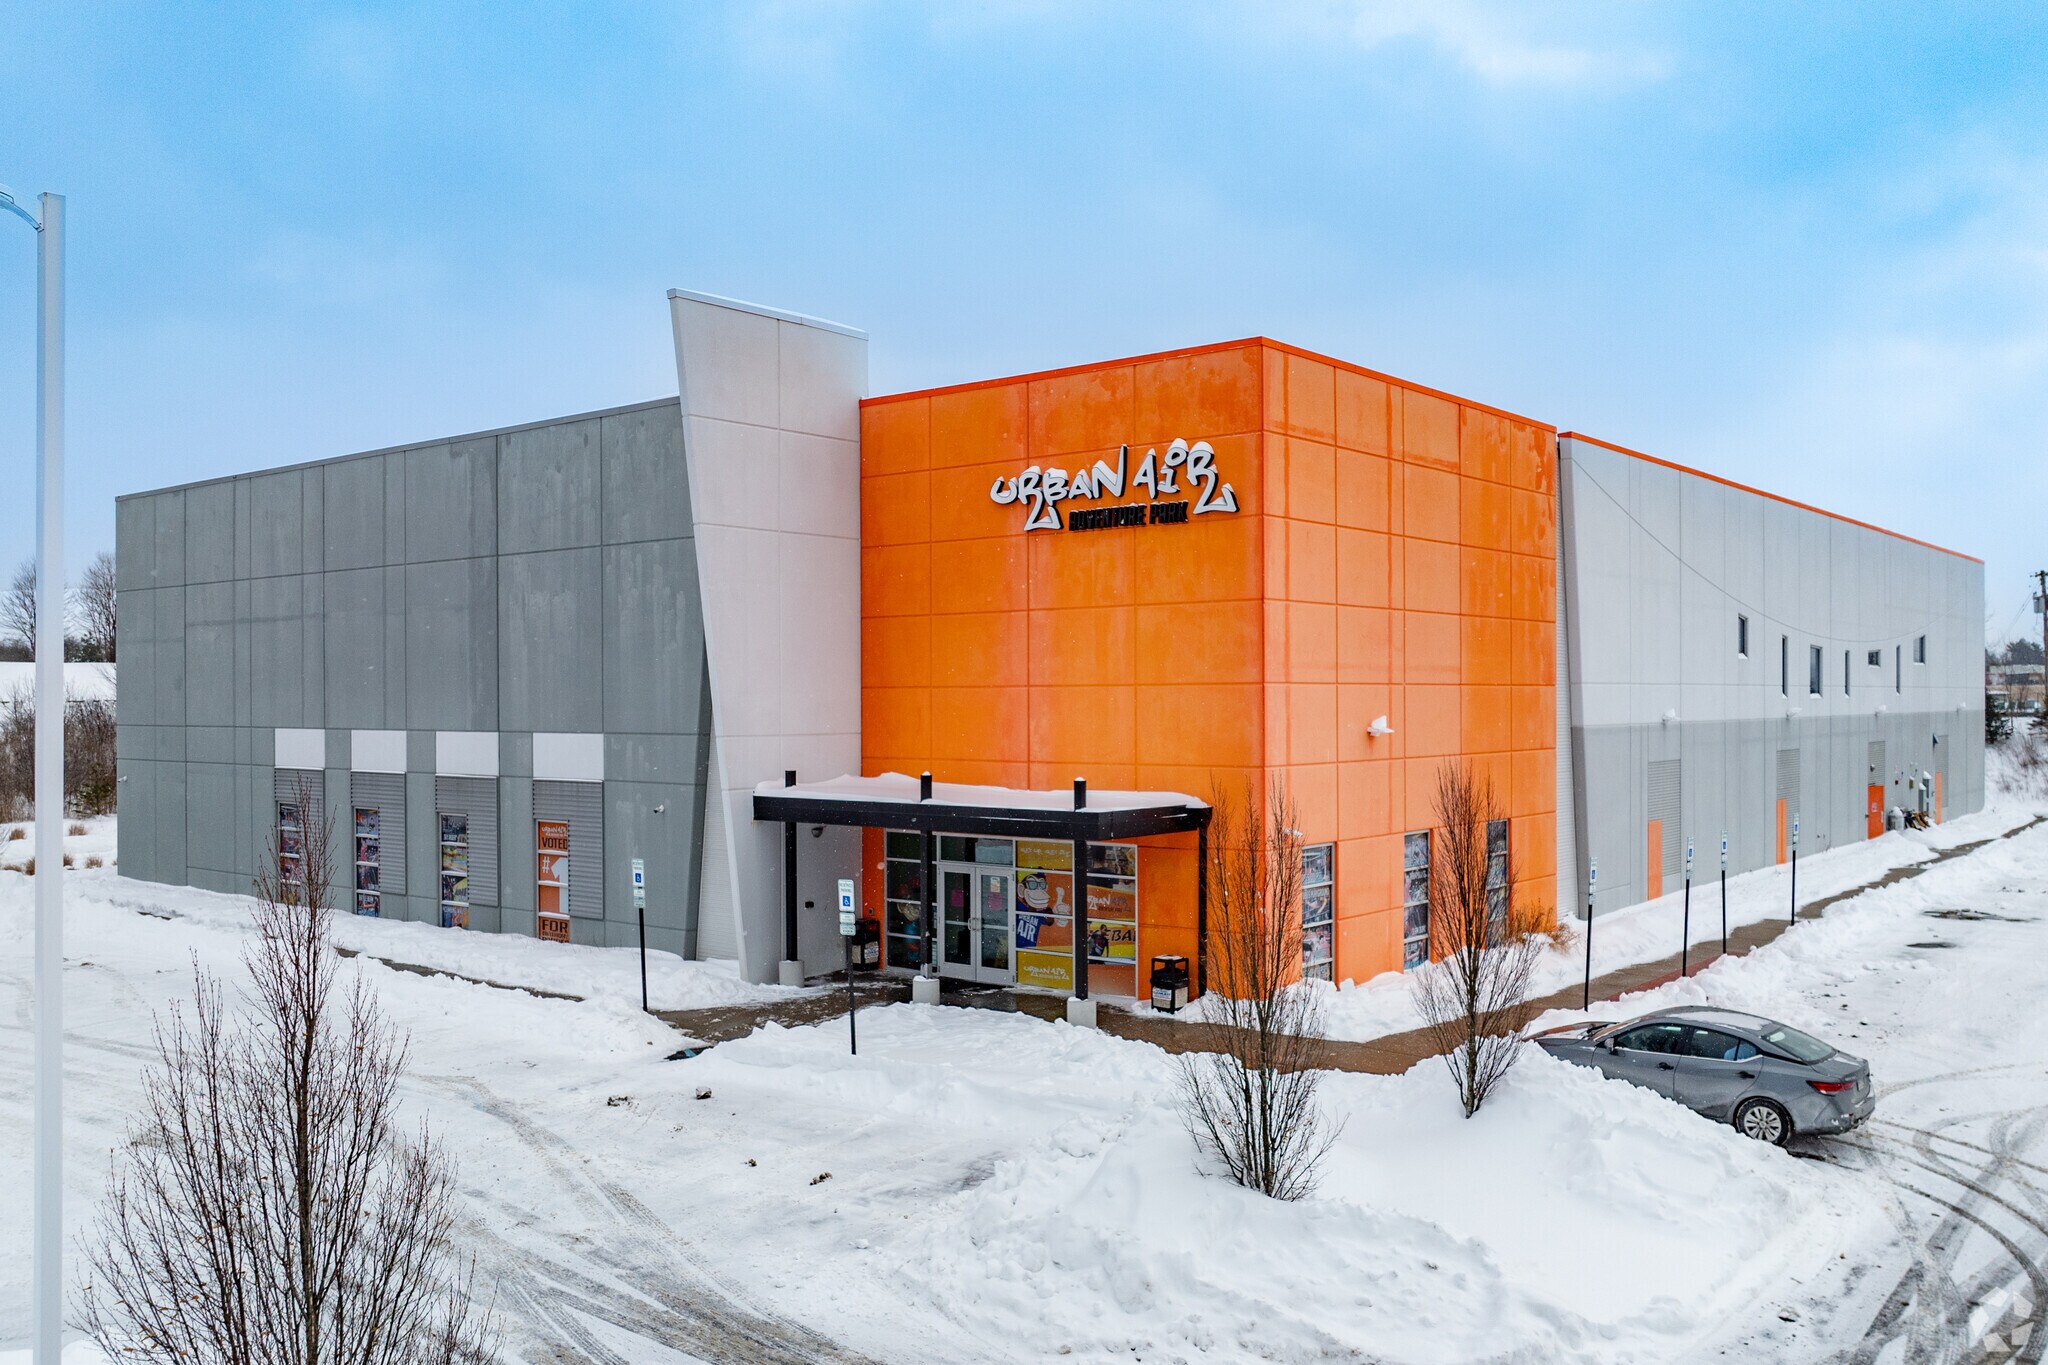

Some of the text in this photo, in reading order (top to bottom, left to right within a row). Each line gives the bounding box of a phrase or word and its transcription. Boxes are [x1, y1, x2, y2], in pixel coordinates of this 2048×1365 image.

[990, 438, 1240, 531] URBAN AIR
[1068, 500, 1189, 531] ADVENTURE PARK
[542, 837, 568, 849] VOTED
[542, 919, 568, 934] FOR
[1016, 920, 1036, 943] AIR
